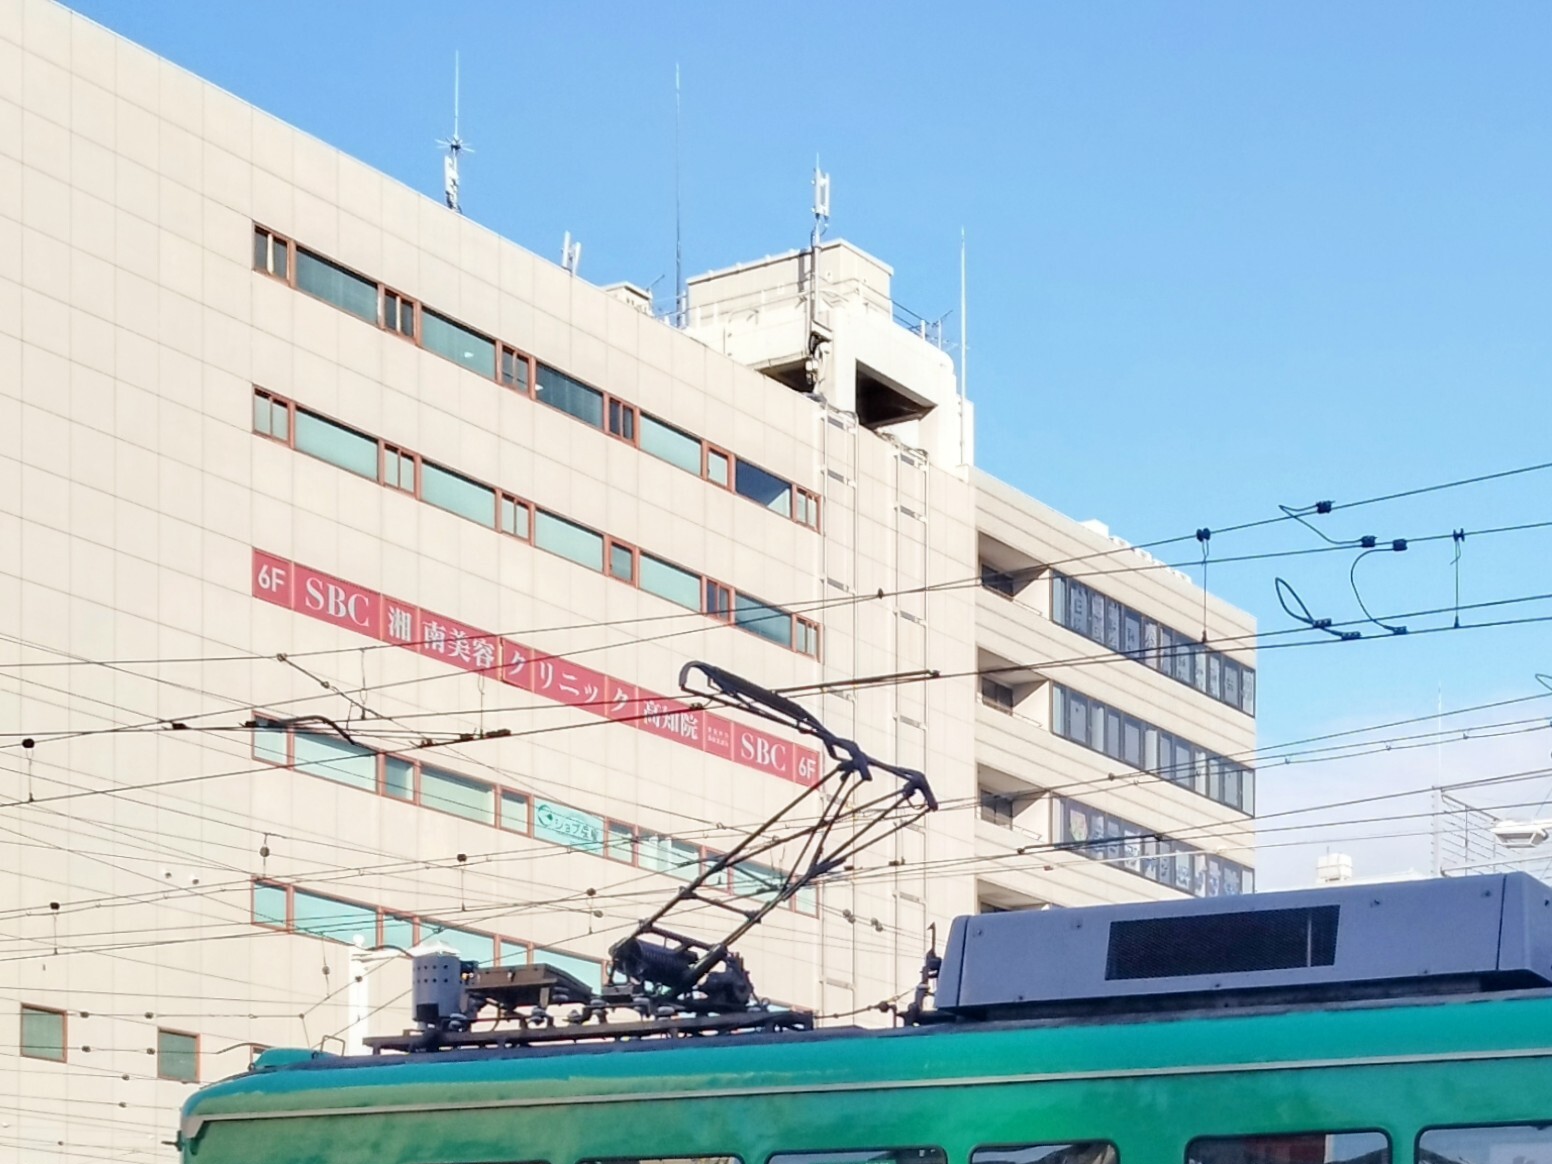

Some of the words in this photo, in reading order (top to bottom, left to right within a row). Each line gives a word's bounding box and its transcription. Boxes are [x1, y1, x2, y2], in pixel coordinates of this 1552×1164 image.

[258, 564, 286, 593] 6F
[306, 576, 370, 627] SBC
[740, 732, 787, 773] SBC
[798, 756, 817, 786] 6F
